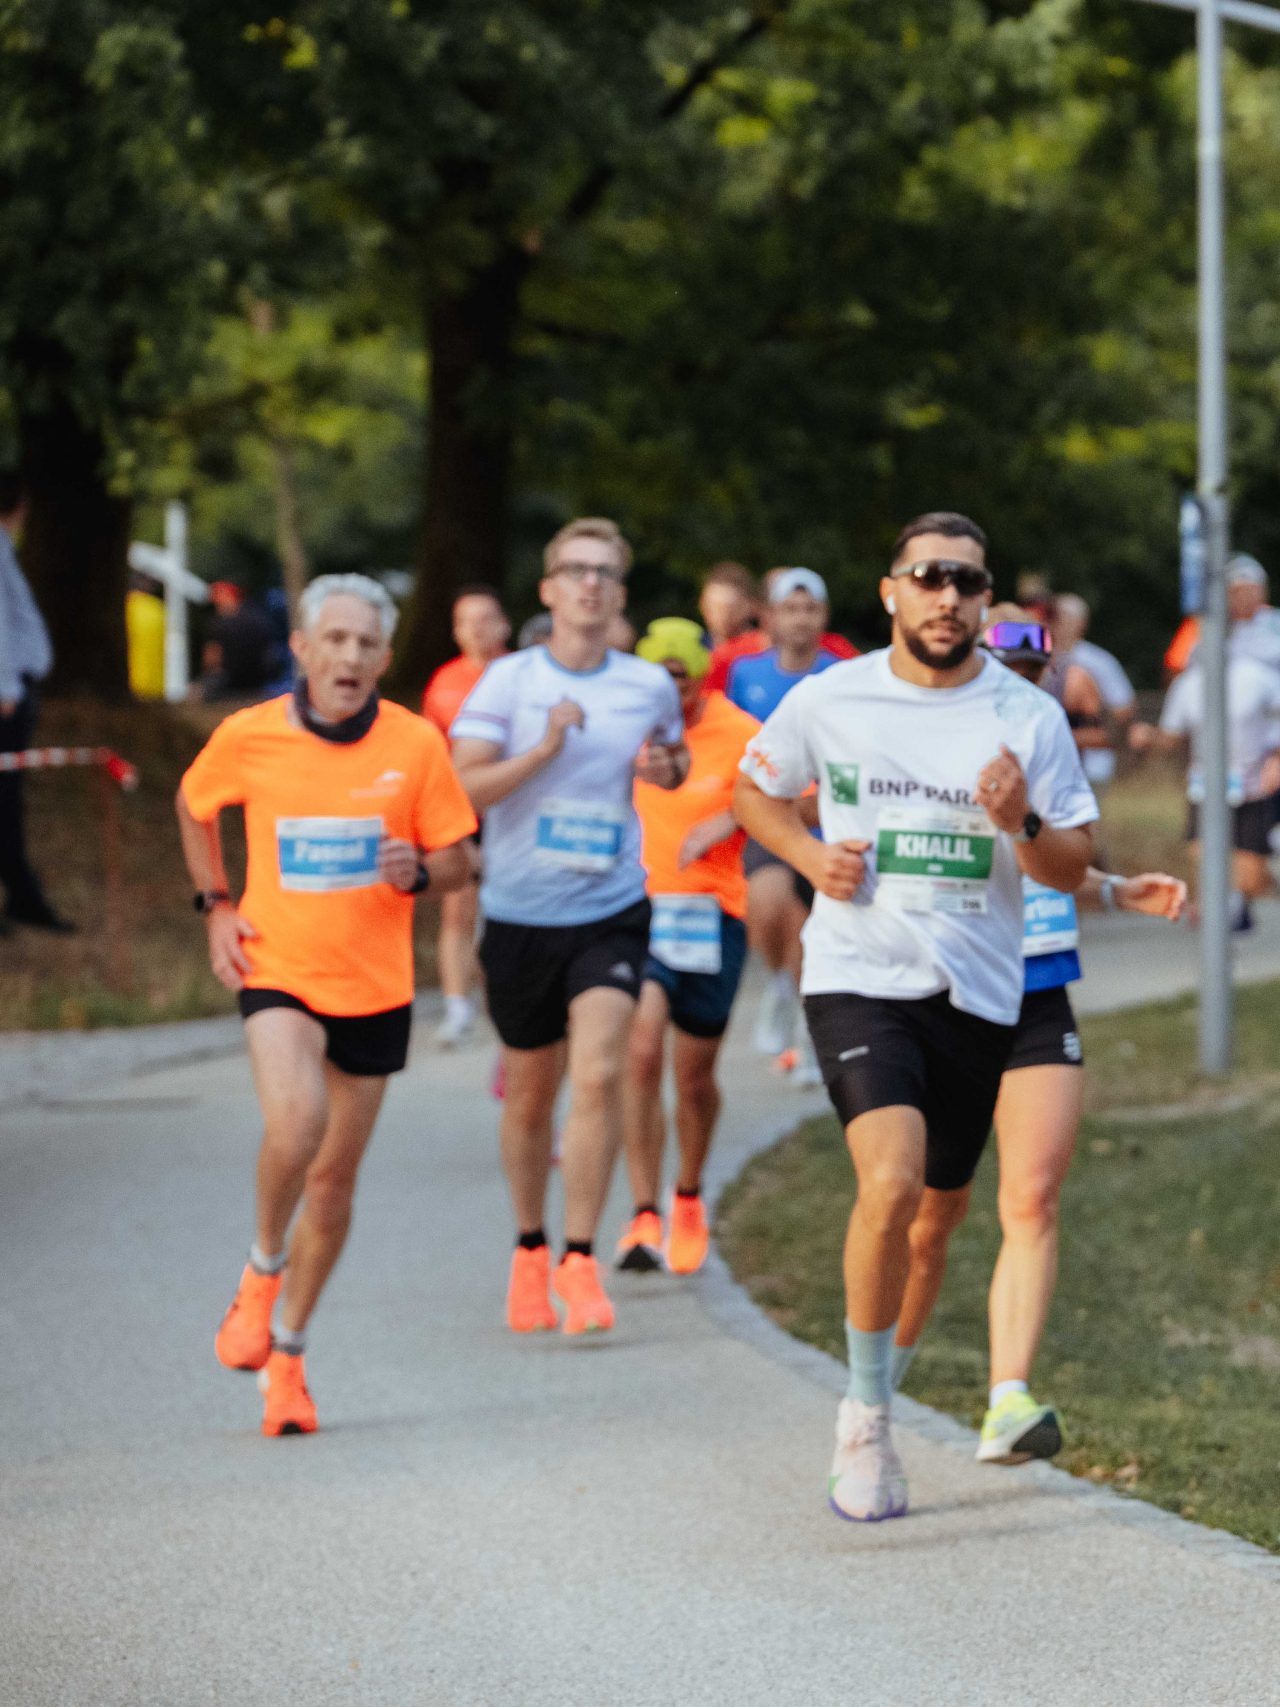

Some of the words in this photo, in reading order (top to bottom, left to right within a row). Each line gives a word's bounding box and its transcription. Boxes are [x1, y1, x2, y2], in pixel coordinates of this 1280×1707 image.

[868, 778, 919, 797] BNP
[923, 785, 979, 806] PAR
[894, 833, 976, 863] KHALIL
